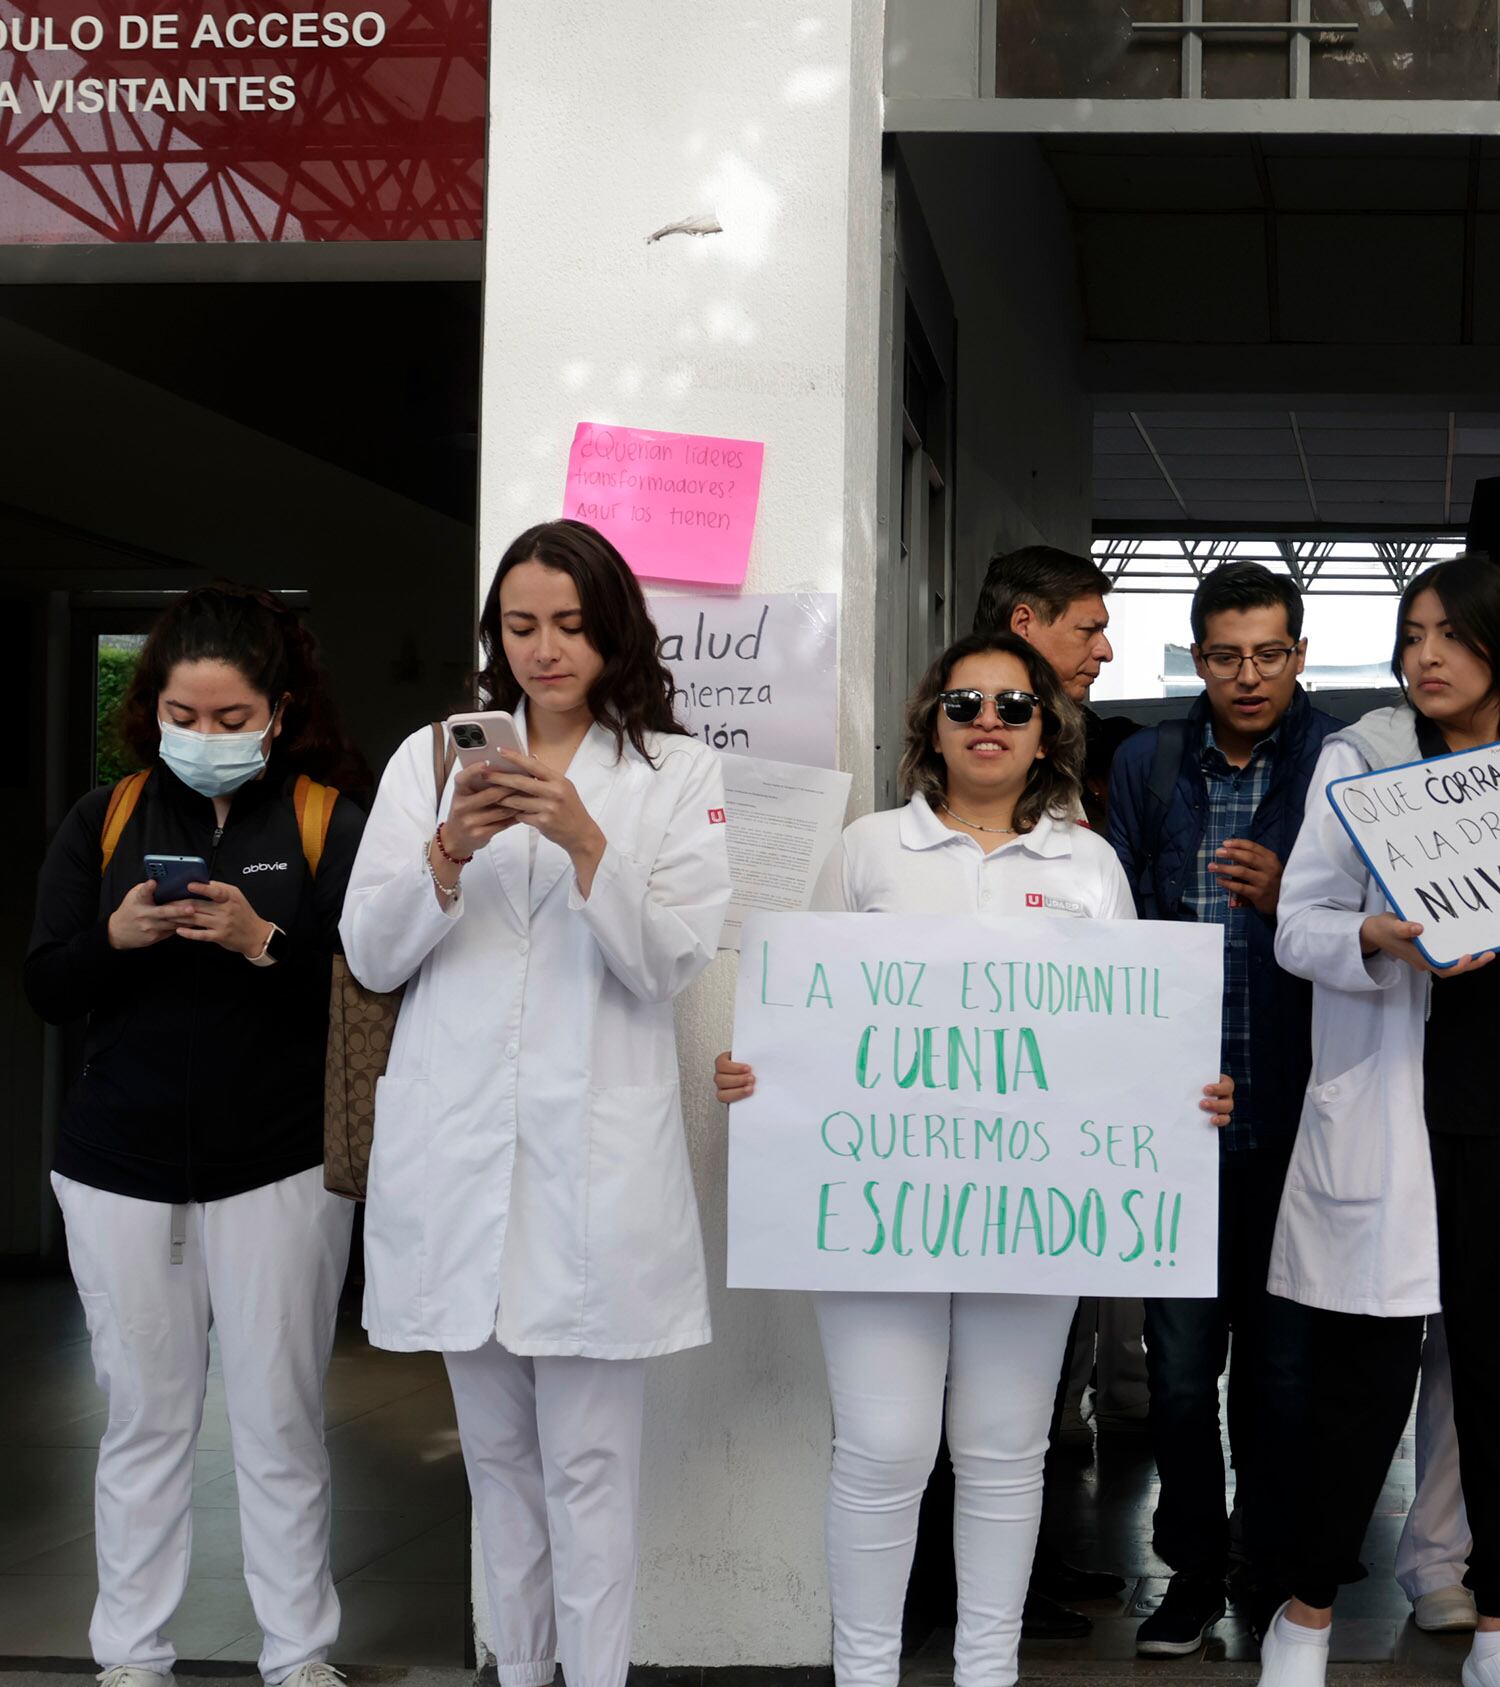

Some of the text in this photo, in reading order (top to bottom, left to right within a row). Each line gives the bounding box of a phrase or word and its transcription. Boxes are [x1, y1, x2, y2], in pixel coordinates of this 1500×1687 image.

[0, 11, 386, 52] ULO DE ACCESO
[33, 75, 297, 114] VISITANTES
[669, 507, 731, 530] tienen
[657, 605, 769, 661] alud
[702, 722, 749, 749] ión
[1342, 782, 1422, 824] QUE
[242, 861, 288, 875] abbvie
[1386, 839, 1413, 871] A
[1415, 831, 1459, 860] LA
[760, 940, 1169, 1019] LA VOZ ESTUDIANTIL
[856, 1025, 1048, 1094] CUENTA
[821, 1111, 1158, 1172] QUEREMOS SER
[816, 1181, 1182, 1268] ESCUCHADOS!!
